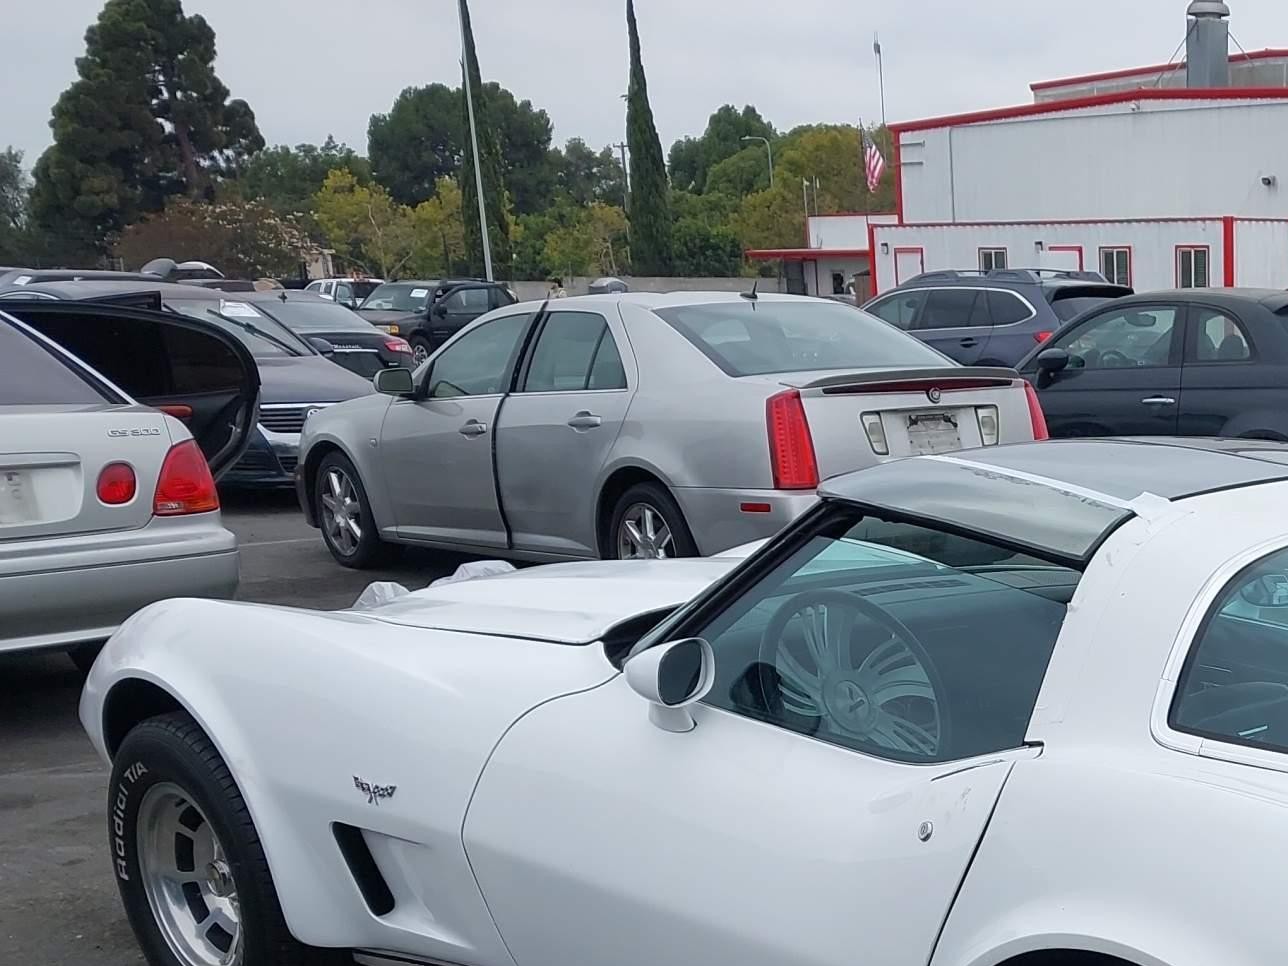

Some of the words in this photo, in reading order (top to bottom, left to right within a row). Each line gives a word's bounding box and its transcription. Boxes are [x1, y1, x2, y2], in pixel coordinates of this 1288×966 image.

[108, 428, 129, 437] GS
[130, 427, 161, 437] 300
[113, 783, 130, 881] Radial
[124, 760, 149, 785] T/A
